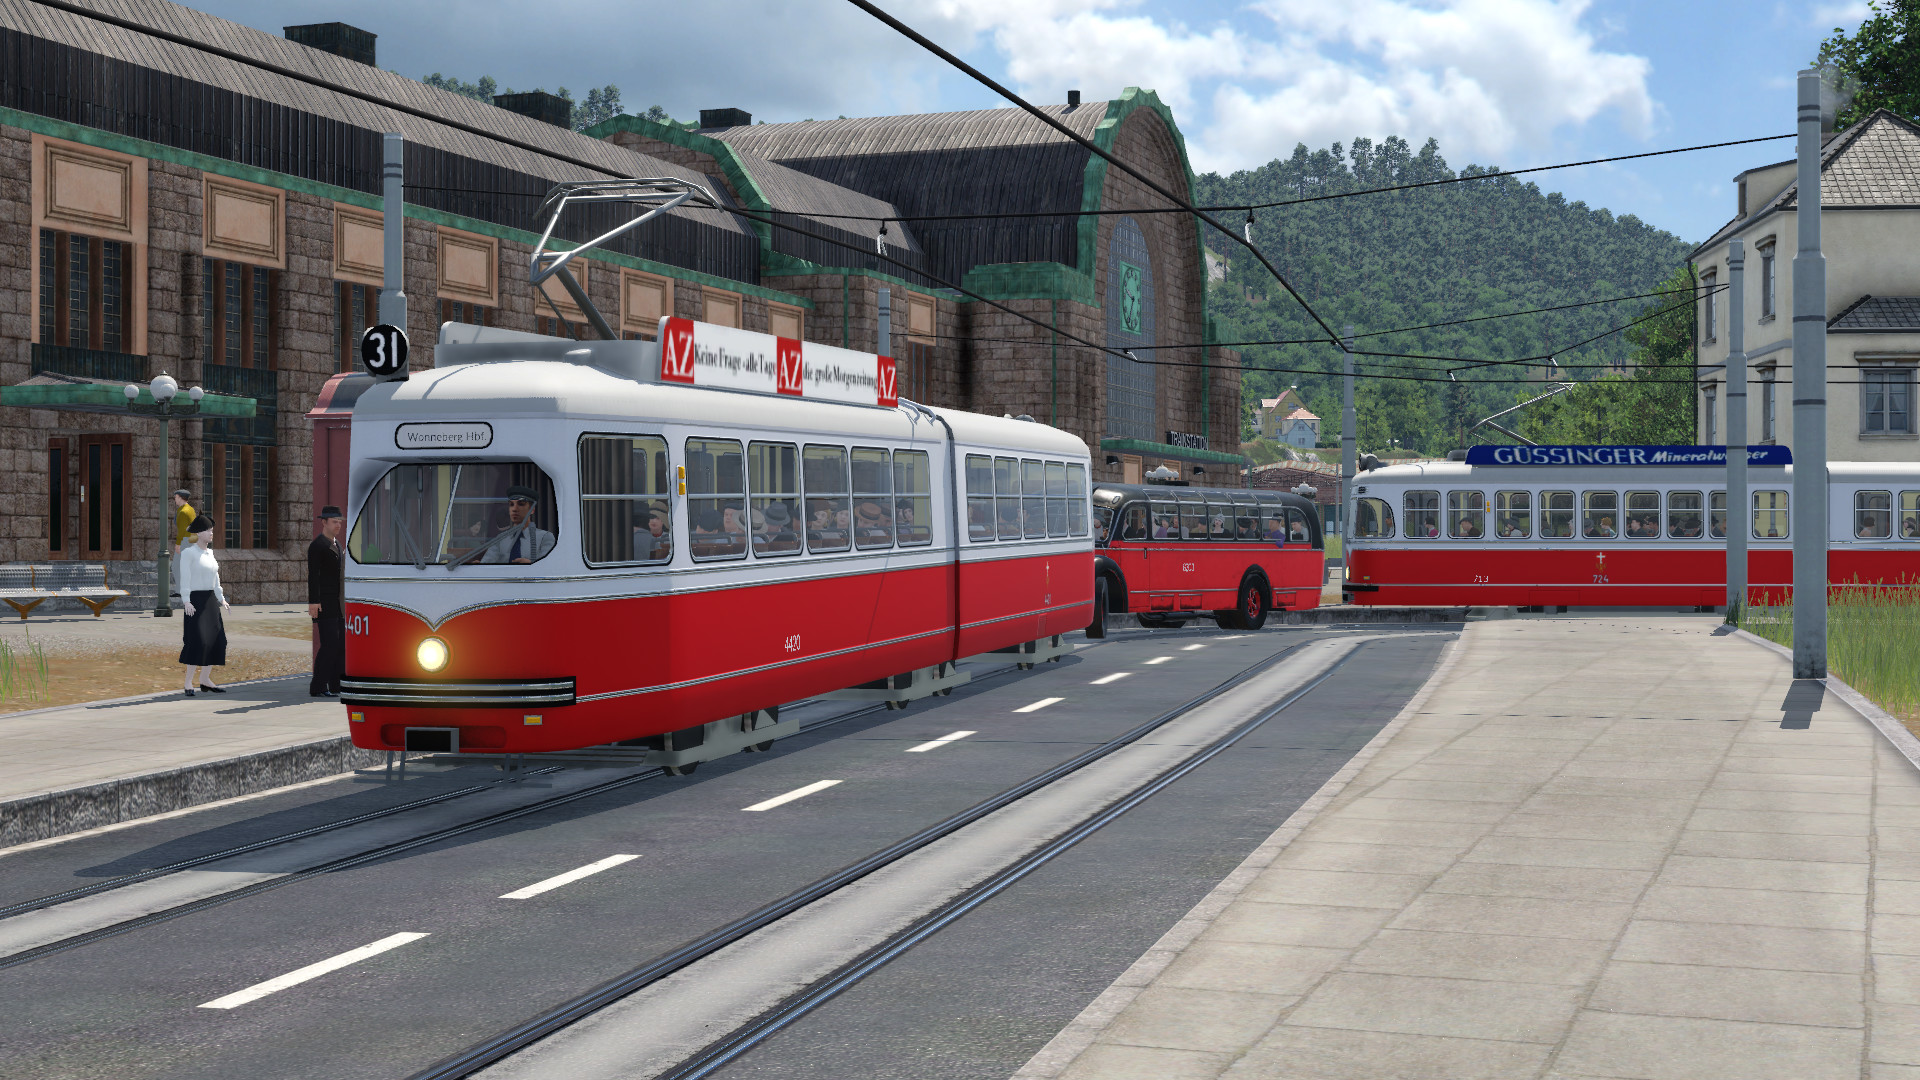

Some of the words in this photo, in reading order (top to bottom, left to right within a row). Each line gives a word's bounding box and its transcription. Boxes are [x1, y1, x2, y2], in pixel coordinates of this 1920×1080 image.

[369, 331, 398, 368] 31
[663, 329, 694, 378] AZ
[694, 343, 718, 368] Keine
[719, 347, 741, 376] Frage
[778, 350, 802, 391] AZ
[803, 361, 813, 380] die
[878, 364, 897, 400] AZ
[407, 432, 463, 443] Wonneberg
[1494, 445, 1648, 464] GÜSSINGER
[1650, 449, 1769, 463] Mineralwser
[1592, 574, 1609, 584] 724
[784, 633, 801, 653] 4420
